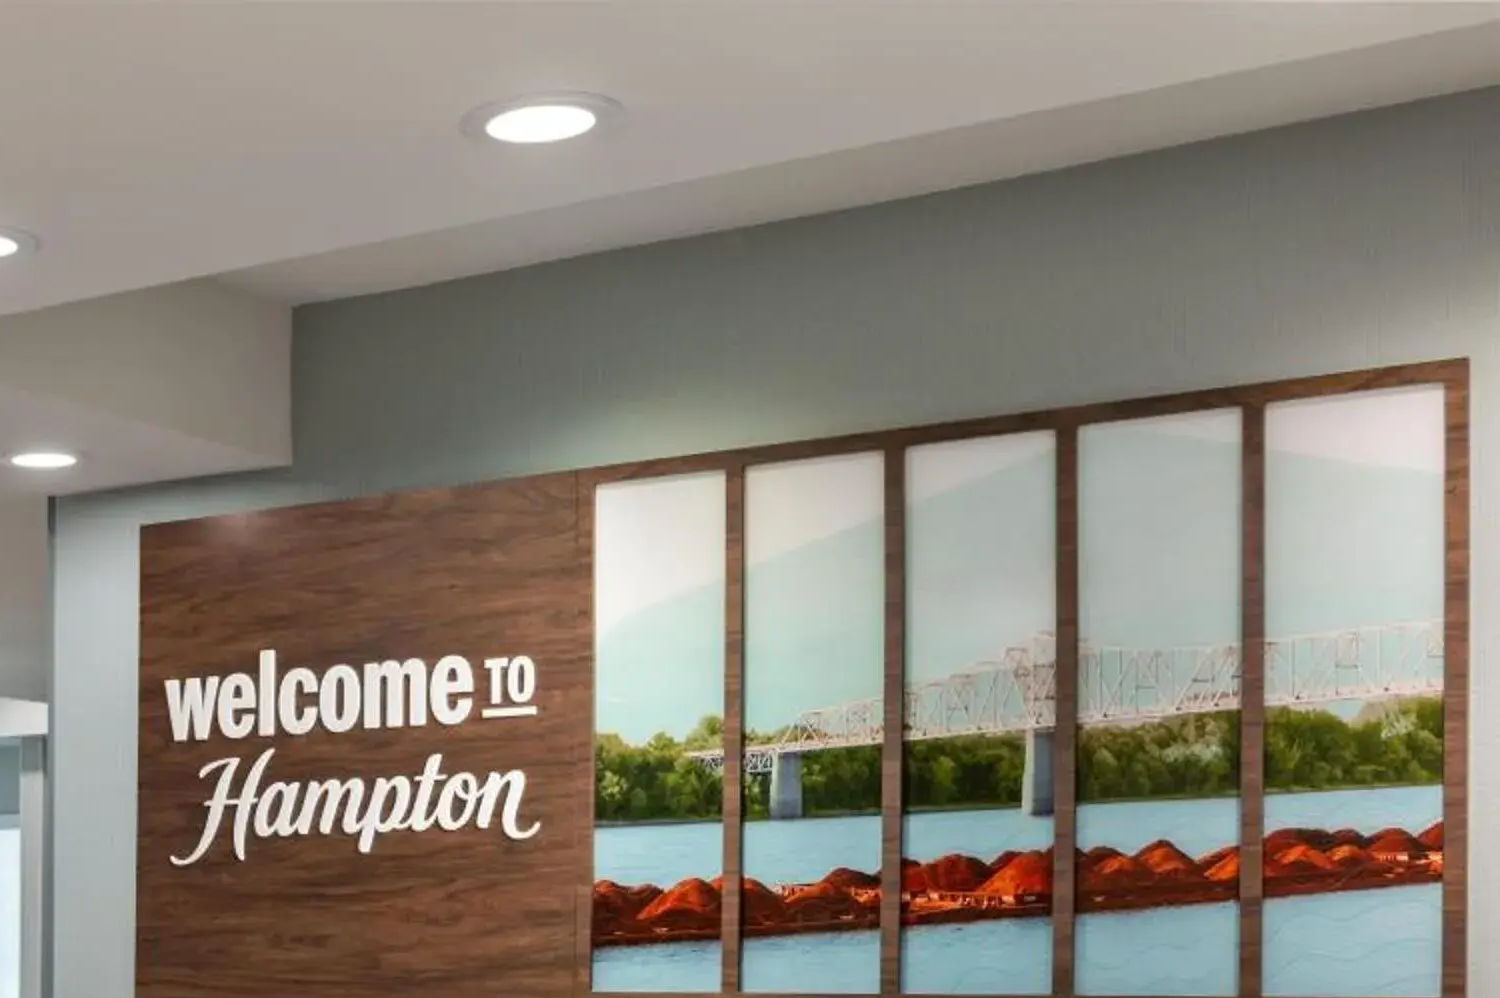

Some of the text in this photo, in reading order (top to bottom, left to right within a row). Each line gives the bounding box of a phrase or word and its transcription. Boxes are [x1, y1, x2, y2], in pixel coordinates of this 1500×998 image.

[163, 649, 537, 742] welcome TO
[169, 748, 541, 866] Hampton
